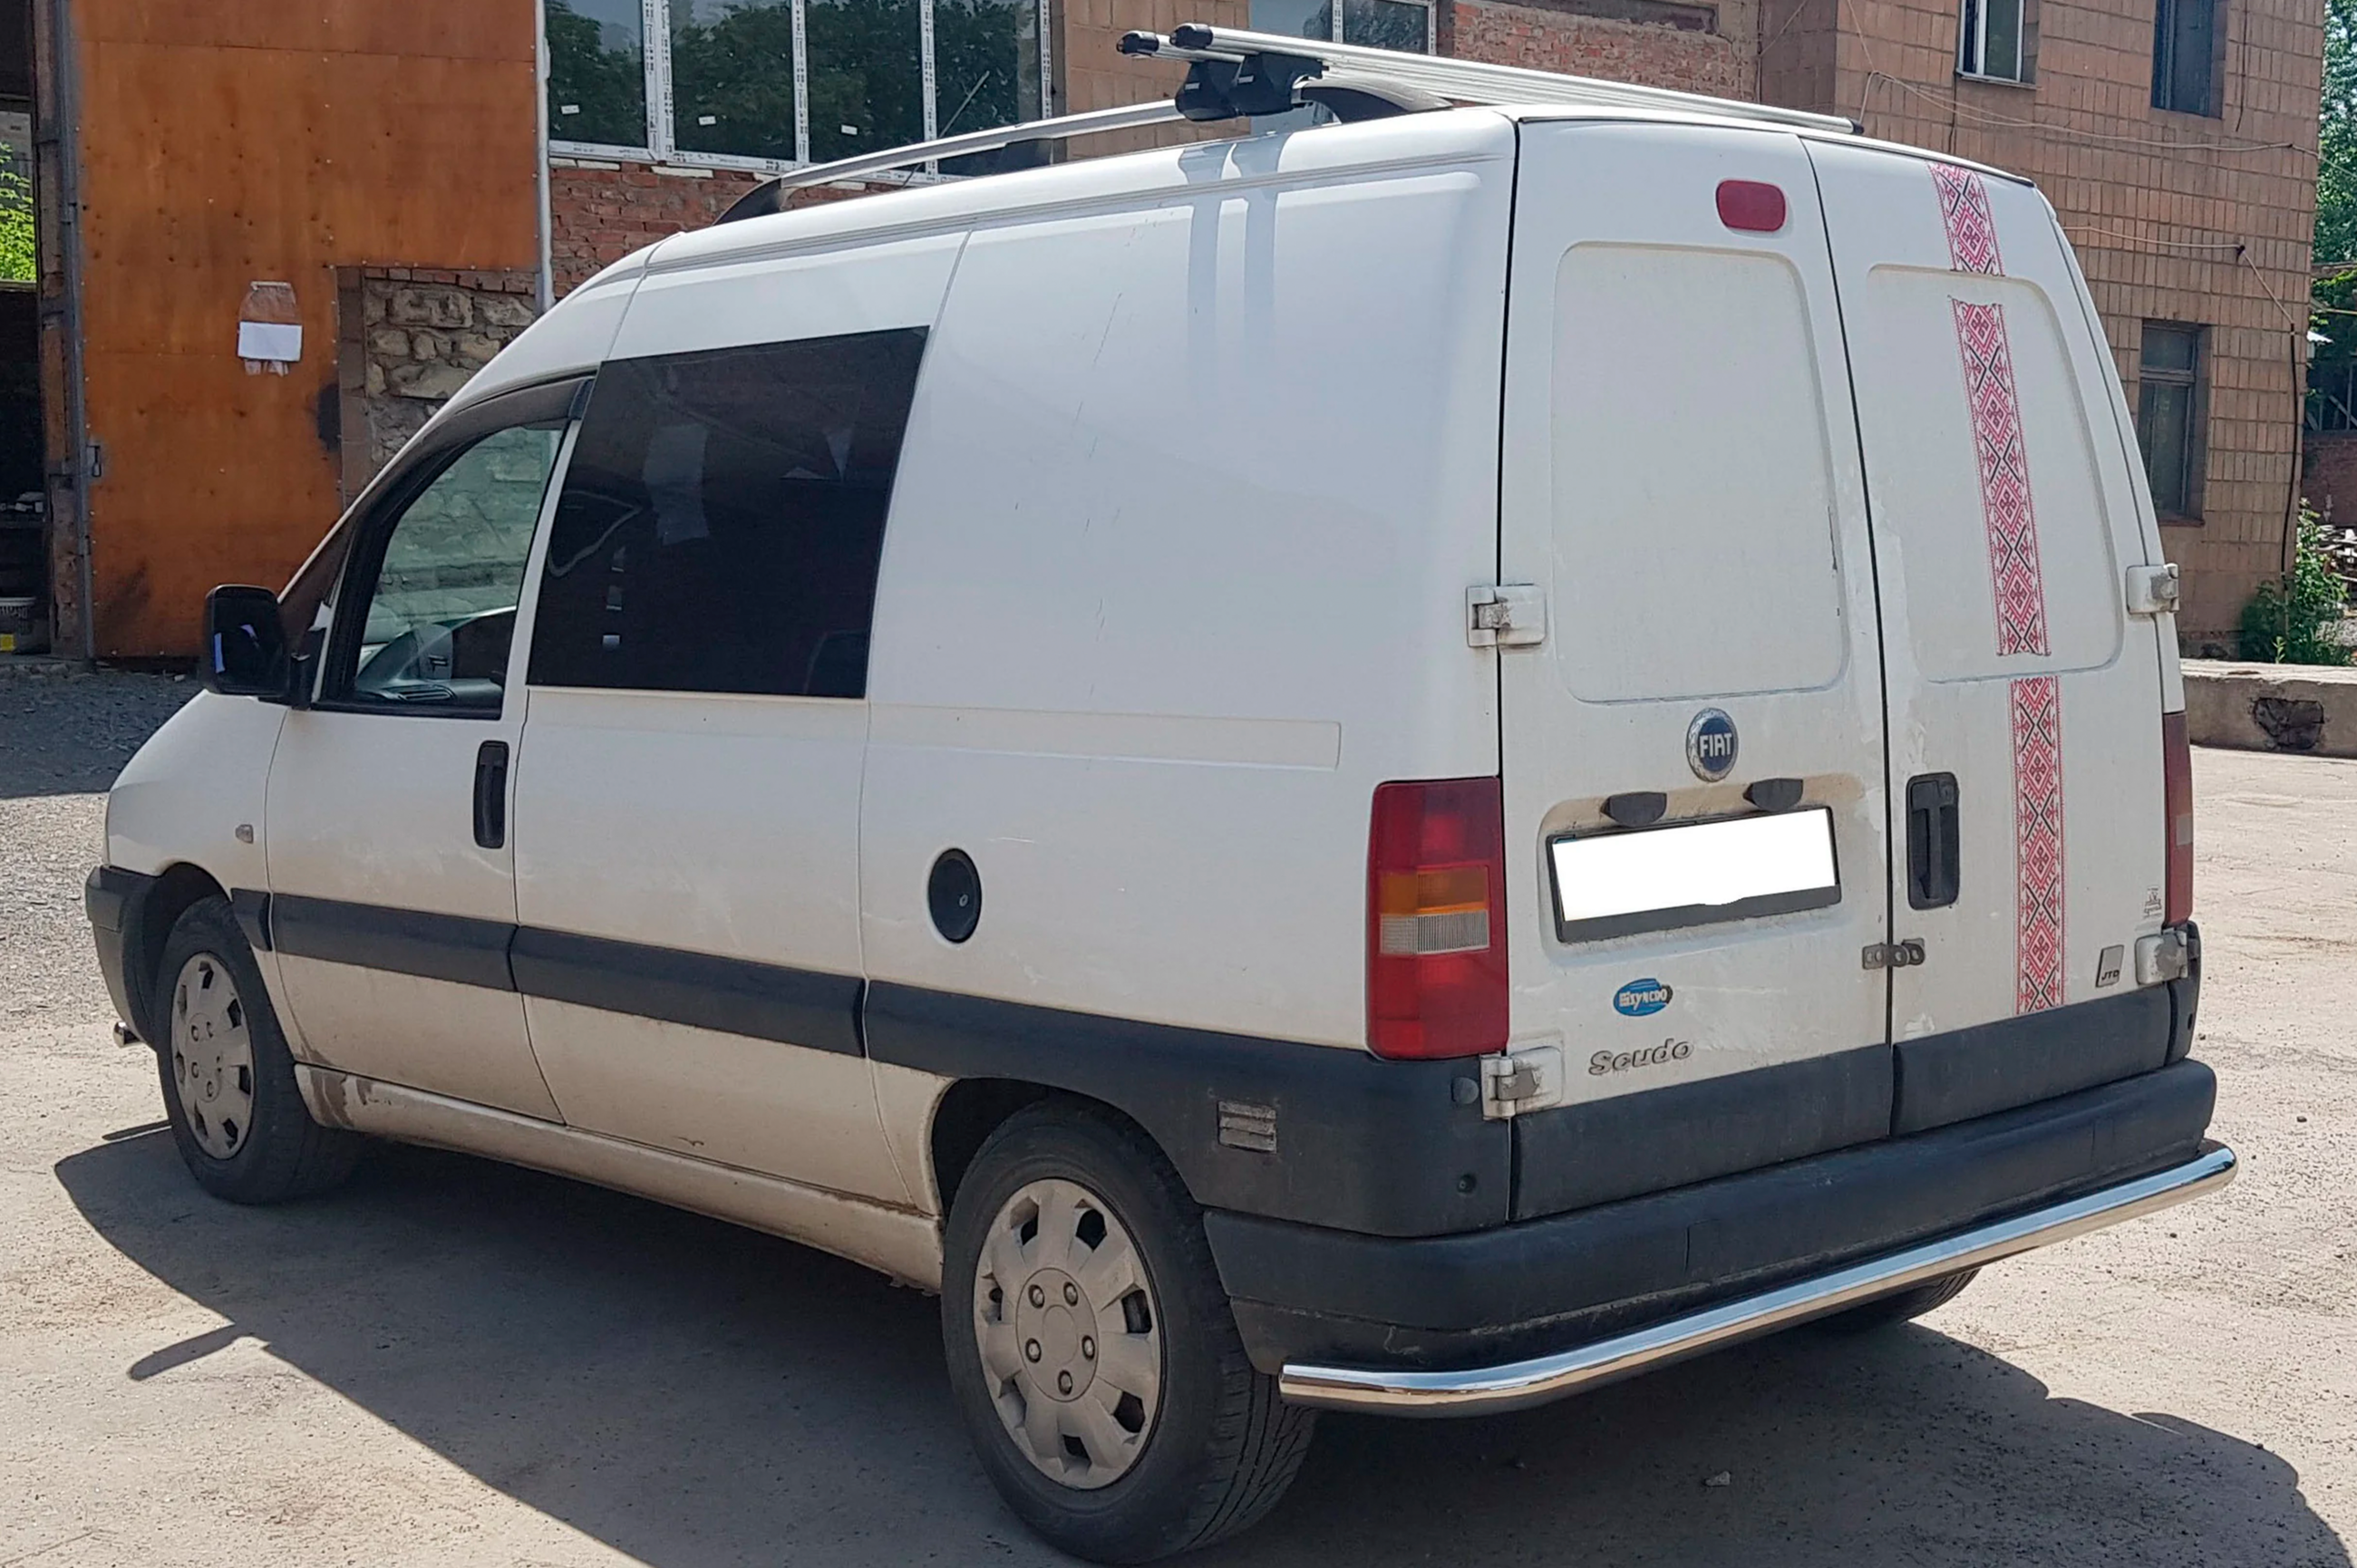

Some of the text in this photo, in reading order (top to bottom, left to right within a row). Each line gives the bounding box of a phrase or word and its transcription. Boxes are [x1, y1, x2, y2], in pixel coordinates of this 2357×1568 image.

[1699, 732, 1732, 758] FIAT
[2101, 969, 2119, 981] JTD
[1588, 1037, 1694, 1076] Scudo
